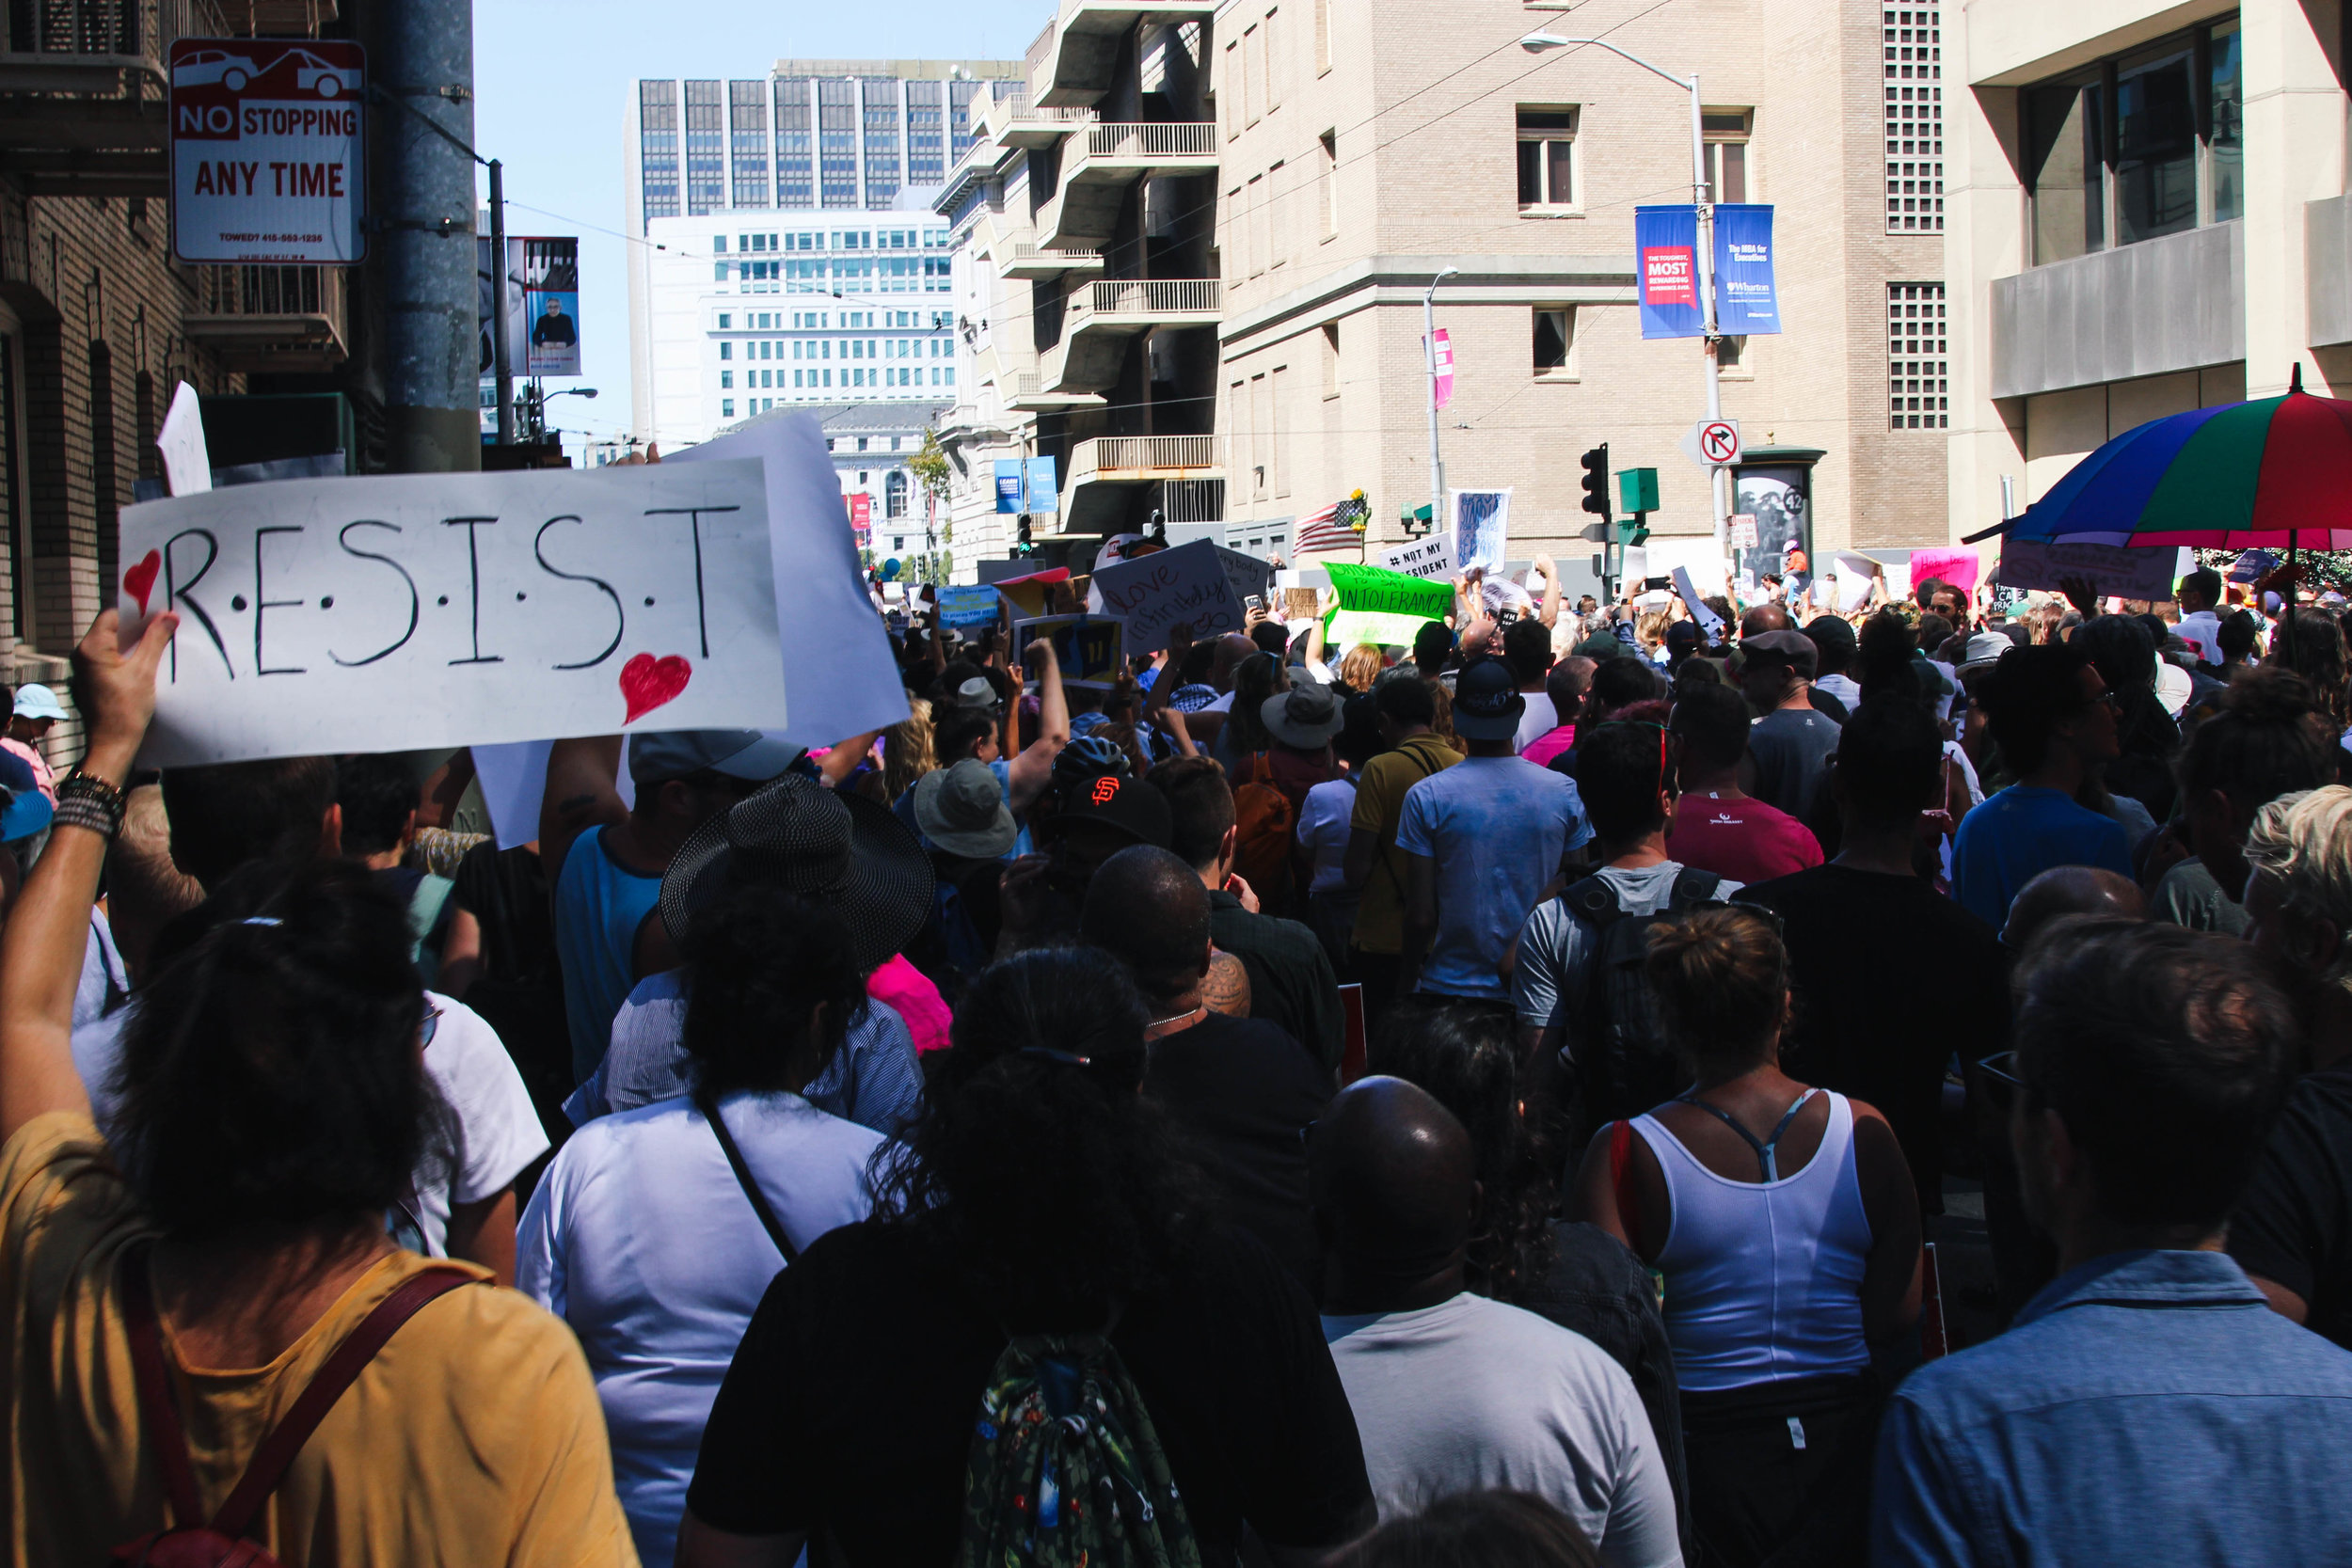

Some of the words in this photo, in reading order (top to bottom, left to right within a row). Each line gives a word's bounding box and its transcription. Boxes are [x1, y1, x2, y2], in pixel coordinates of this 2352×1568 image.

[180, 105, 233, 133] NO
[244, 107, 357, 136] STOPPING
[195, 161, 259, 196] ANY
[269, 162, 344, 198] TIME
[1648, 262, 1688, 276] MOST
[1734, 282, 1770, 292] Wharton
[1403, 548, 1422, 563] NOT
[1426, 542, 1441, 557] MY
[1105, 564, 1180, 615] love
[1342, 588, 1451, 612] INTOLERANCE
